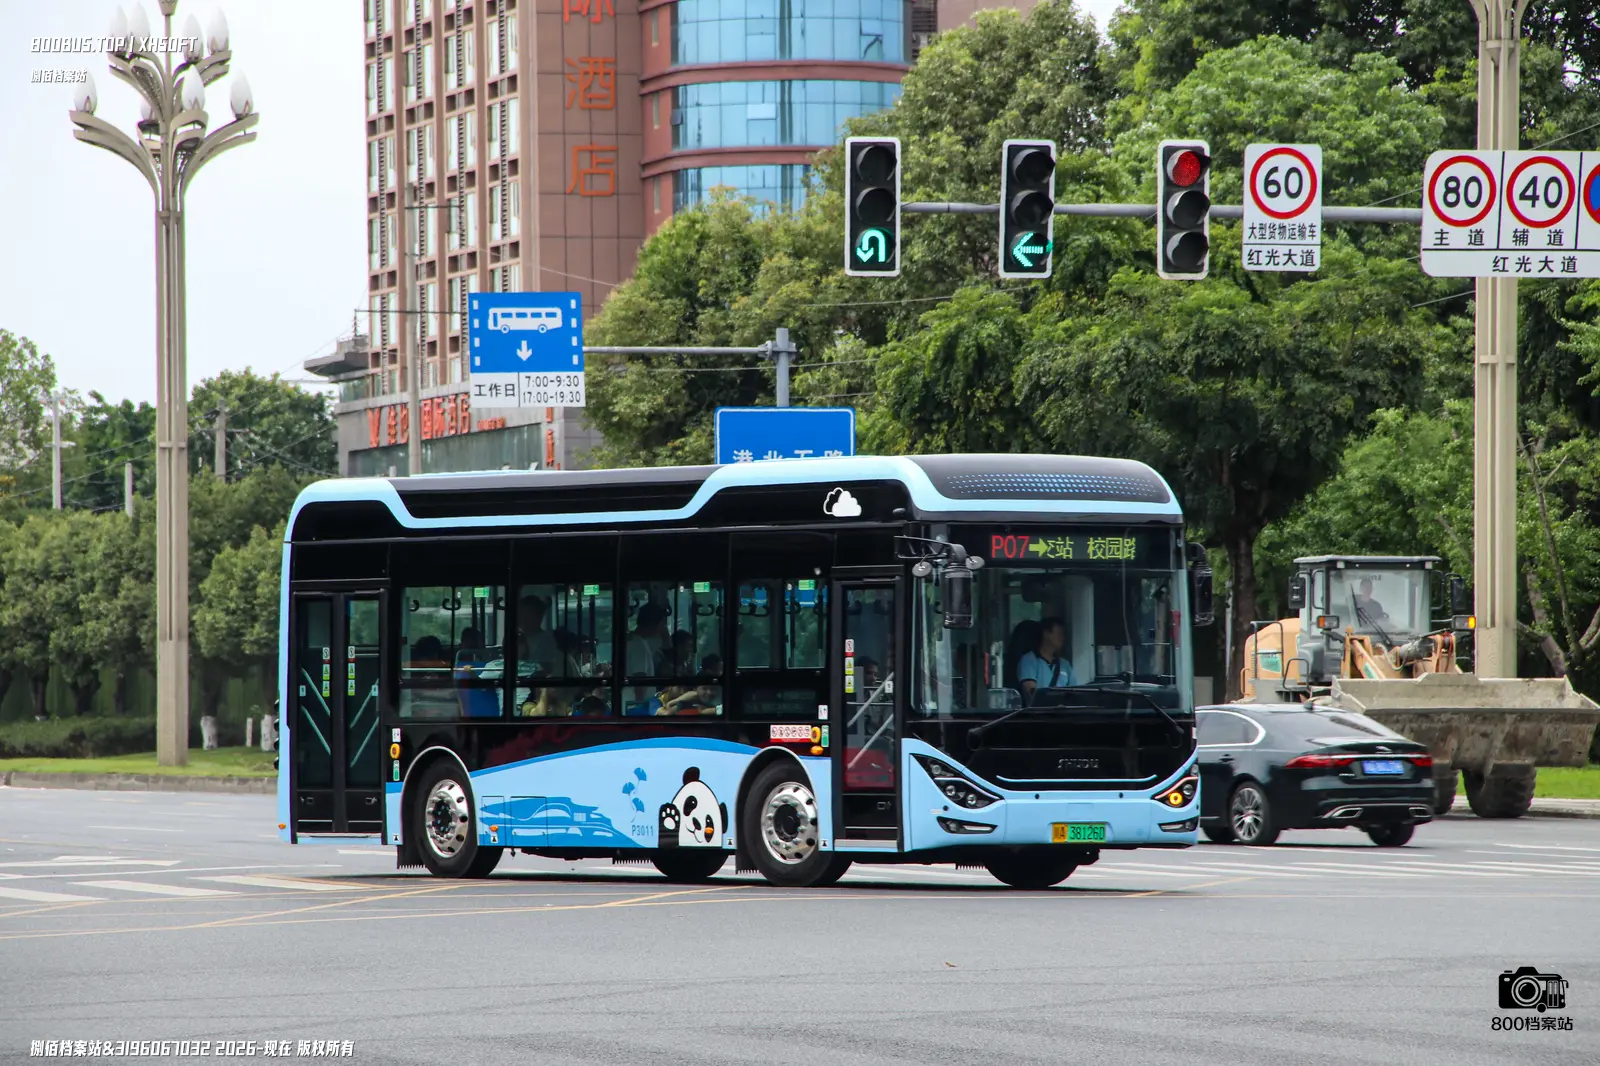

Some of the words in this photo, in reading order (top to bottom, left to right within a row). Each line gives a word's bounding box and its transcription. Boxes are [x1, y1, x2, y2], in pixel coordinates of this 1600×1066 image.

[1263, 166, 1303, 199] 60
[1443, 176, 1483, 208] 80
[1519, 176, 1563, 208] 40
[1248, 222, 1317, 241] 大型货物运输车
[1433, 229, 1485, 246] 主道
[1512, 229, 1564, 246] 辅道
[1247, 249, 1316, 267] 红光大道
[1492, 255, 1578, 273] 红光大道
[474, 384, 516, 398] 工作日
[524, 376, 580, 388] 7:00-9:30
[522, 391, 581, 404] 17:00-19:30
[991, 535, 1030, 558] P07
[1087, 537, 1136, 560] 校园路
[631, 825, 654, 836] P3011
